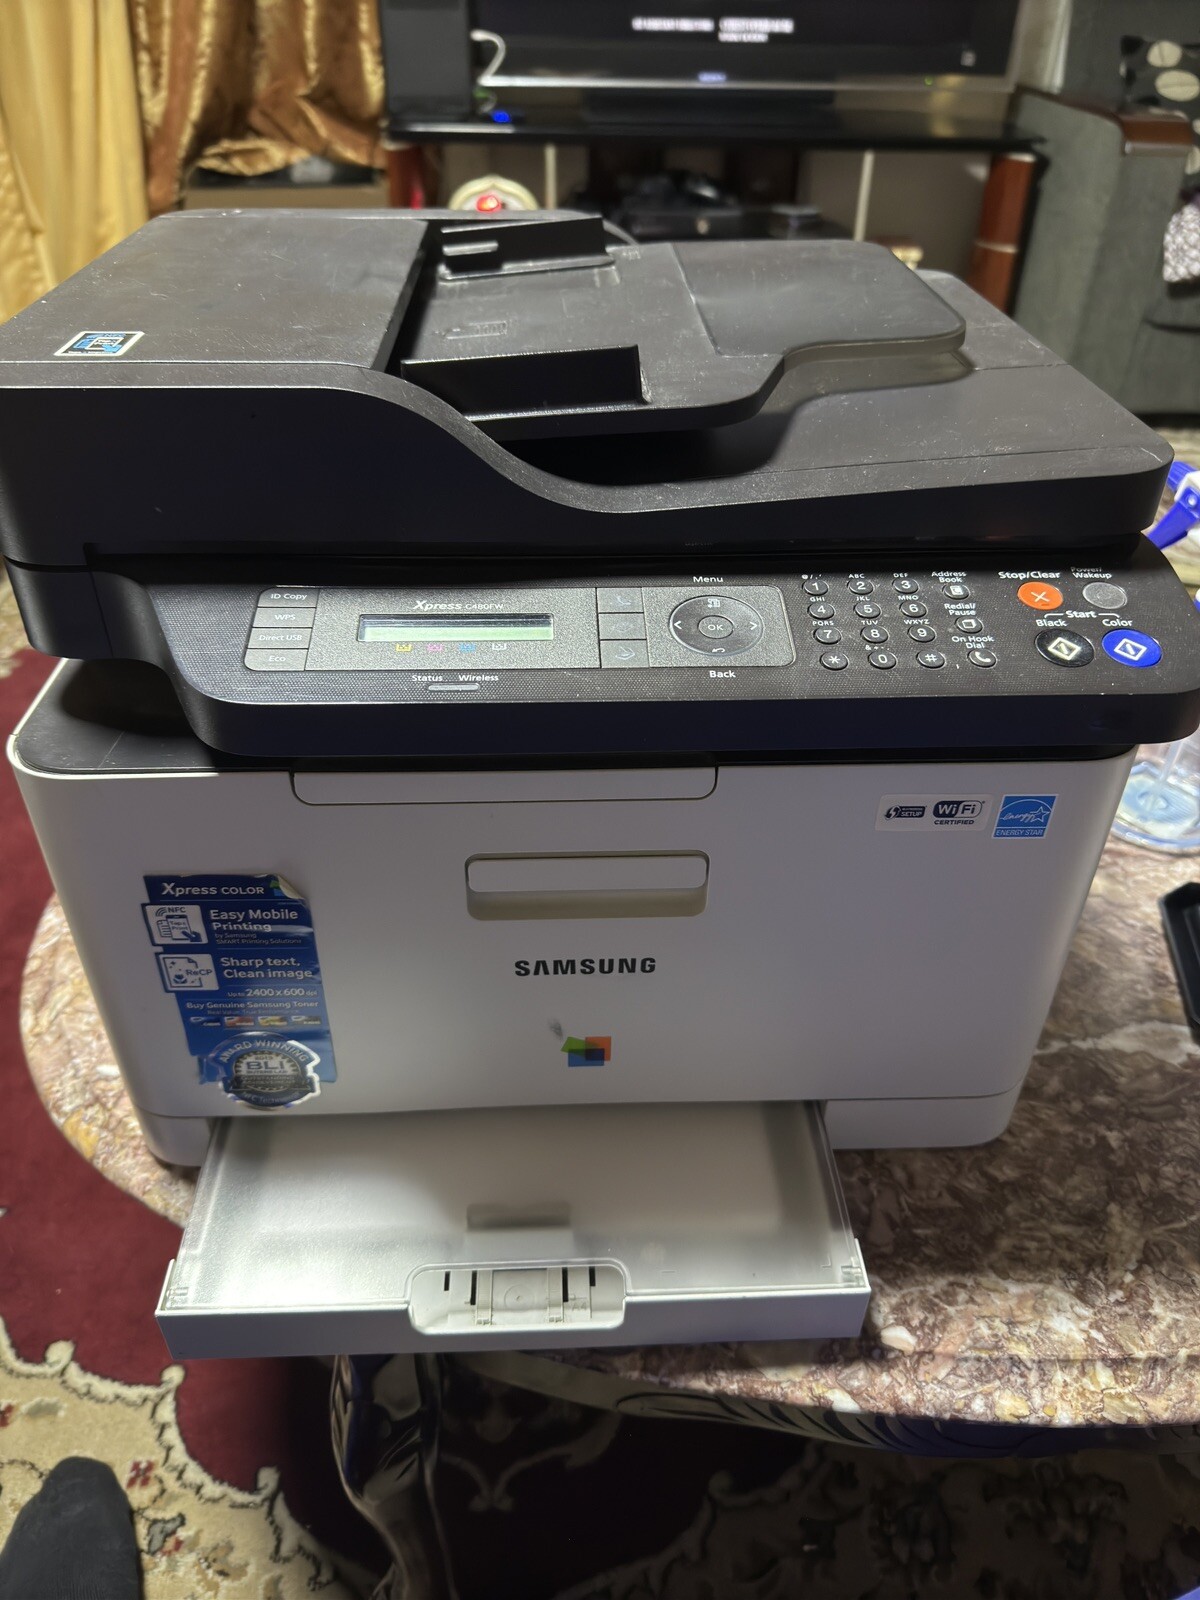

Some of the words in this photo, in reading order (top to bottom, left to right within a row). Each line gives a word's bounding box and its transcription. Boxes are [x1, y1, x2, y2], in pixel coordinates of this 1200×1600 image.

[998, 571, 1061, 580] Stop/Clear
[1072, 572, 1112, 580] Wakeup
[812, 582, 818, 591] 1
[857, 582, 866, 590] 2
[901, 581, 911, 589] 3
[283, 593, 308, 601] Copy
[413, 600, 462, 611] Xpress
[817, 605, 827, 614] 4
[863, 604, 873, 613] 5
[909, 604, 919, 613] 6
[1065, 610, 1097, 619] Start
[1035, 619, 1067, 627] Black
[1102, 619, 1133, 627] Color
[823, 629, 833, 639] 7
[870, 629, 880, 638] 8
[917, 628, 927, 637] 9
[951, 635, 967, 643] On
[967, 635, 995, 643] Hook
[878, 654, 888, 664] 0
[709, 670, 736, 678] Back
[901, 810, 923, 818] SETUP
[995, 829, 1024, 837] ENERGY
[1024, 829, 1044, 837] STAR
[162, 882, 218, 897] Xpress
[220, 886, 265, 895] COLOR
[167, 906, 187, 914] NFC
[210, 909, 245, 922] Easy
[249, 908, 299, 920] Mobile
[212, 921, 272, 932] Printing
[220, 957, 264, 968] Sharp
[267, 957, 301, 968] text,
[514, 957, 657, 977] SAMSUNG
[186, 969, 213, 977] ReCP
[223, 969, 265, 979] Clean
[267, 969, 313, 980] image
[246, 988, 274, 997] 2400
[283, 988, 305, 996] 600
[186, 1002, 205, 1010] Buy
[207, 1001, 246, 1009] Genuine
[247, 1001, 291, 1009] Samsung
[254, 1039, 311, 1063] WINNING
[245, 1061, 286, 1070] BLI
